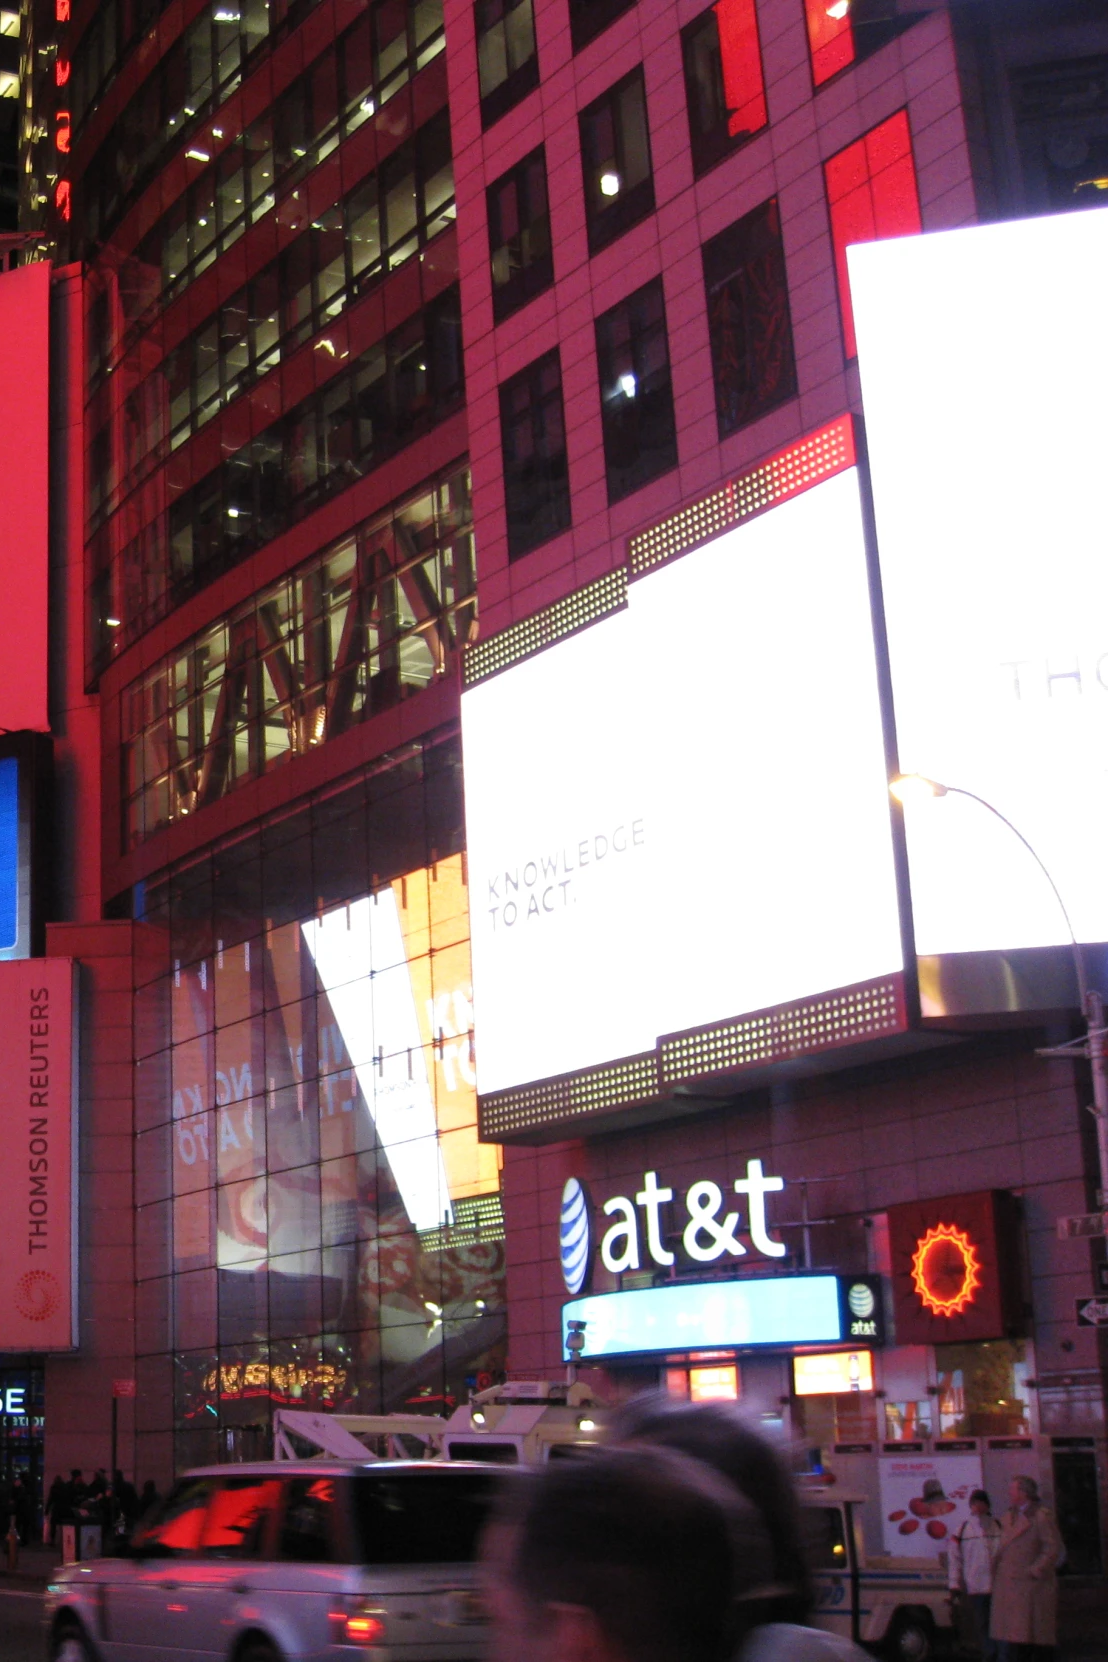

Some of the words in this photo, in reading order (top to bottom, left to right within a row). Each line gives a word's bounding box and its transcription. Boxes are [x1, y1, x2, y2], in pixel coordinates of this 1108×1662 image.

[488, 818, 645, 903] KNOWLEDGE
[488, 901, 518, 933] TO
[527, 879, 577, 921] ACT.
[28, 986, 50, 1108] REUTERS
[28, 1117, 49, 1255] THOMSON
[601, 1159, 786, 1274] at&t
[850, 1320, 877, 1336] at&t
